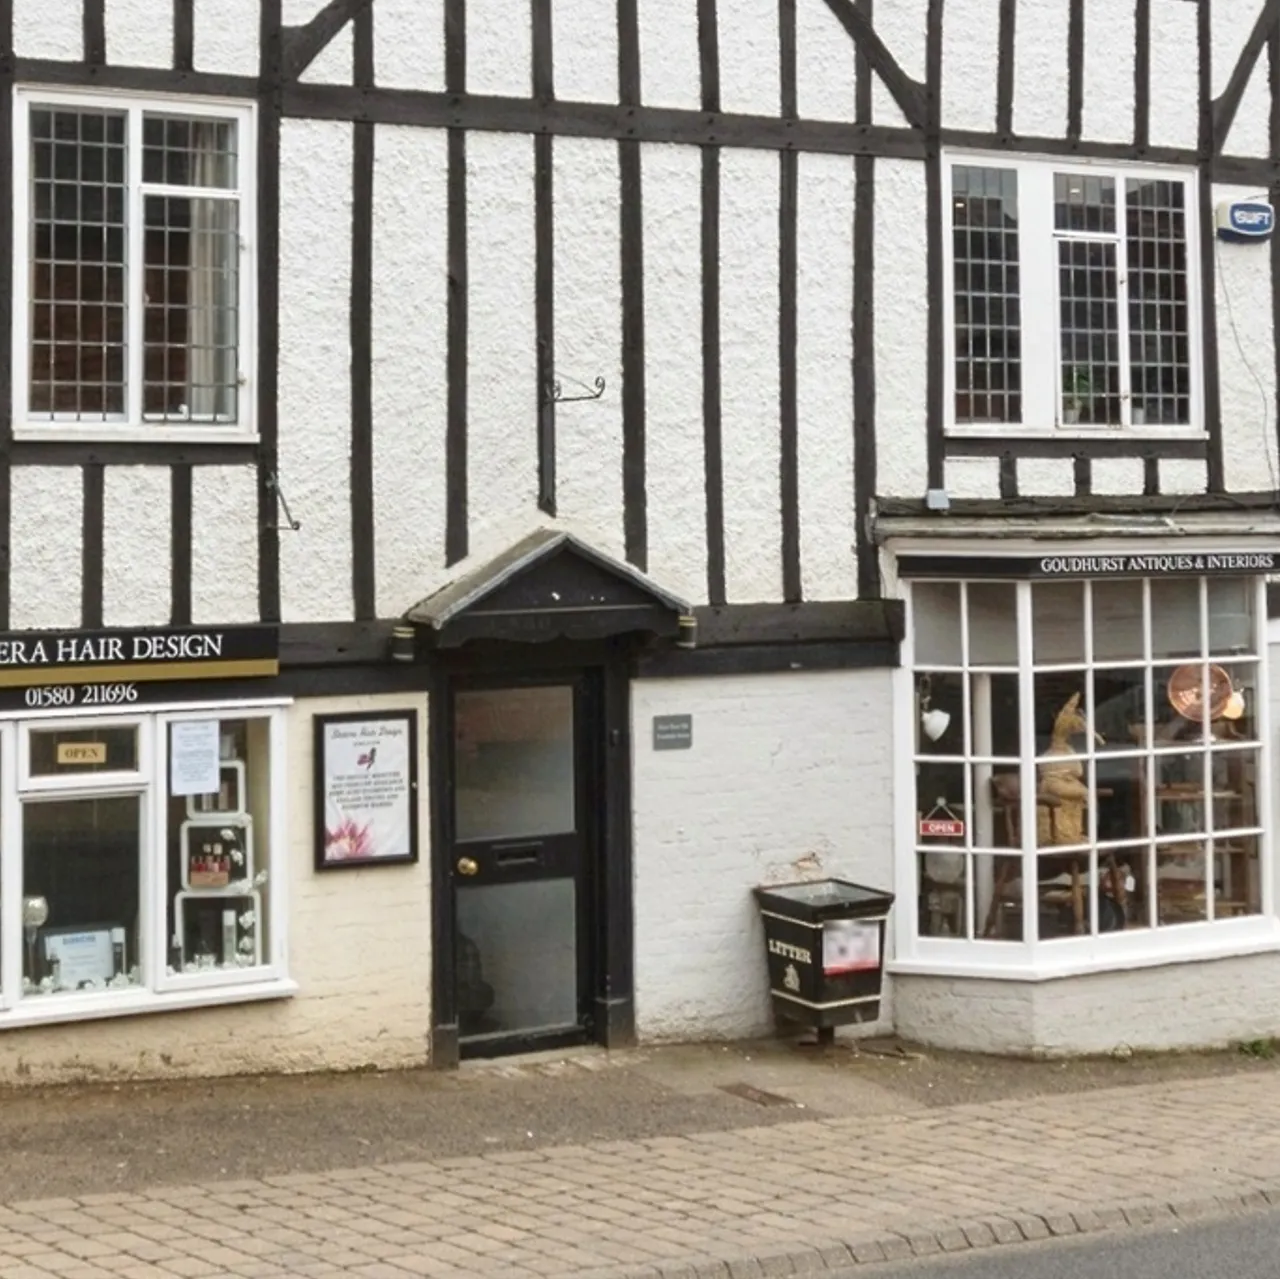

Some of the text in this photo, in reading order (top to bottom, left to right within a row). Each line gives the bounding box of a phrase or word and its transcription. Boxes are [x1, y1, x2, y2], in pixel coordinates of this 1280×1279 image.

[1040, 553, 1275, 572] GOUDHURST ANTIQUES & INTERIORS
[56, 637, 125, 663] HAIR
[132, 634, 223, 660] DESIGN
[24, 683, 138, 707] 01580 211696
[63, 747, 100, 759] OPEN
[929, 822, 955, 833] OPEN
[768, 938, 812, 965] LITTER
